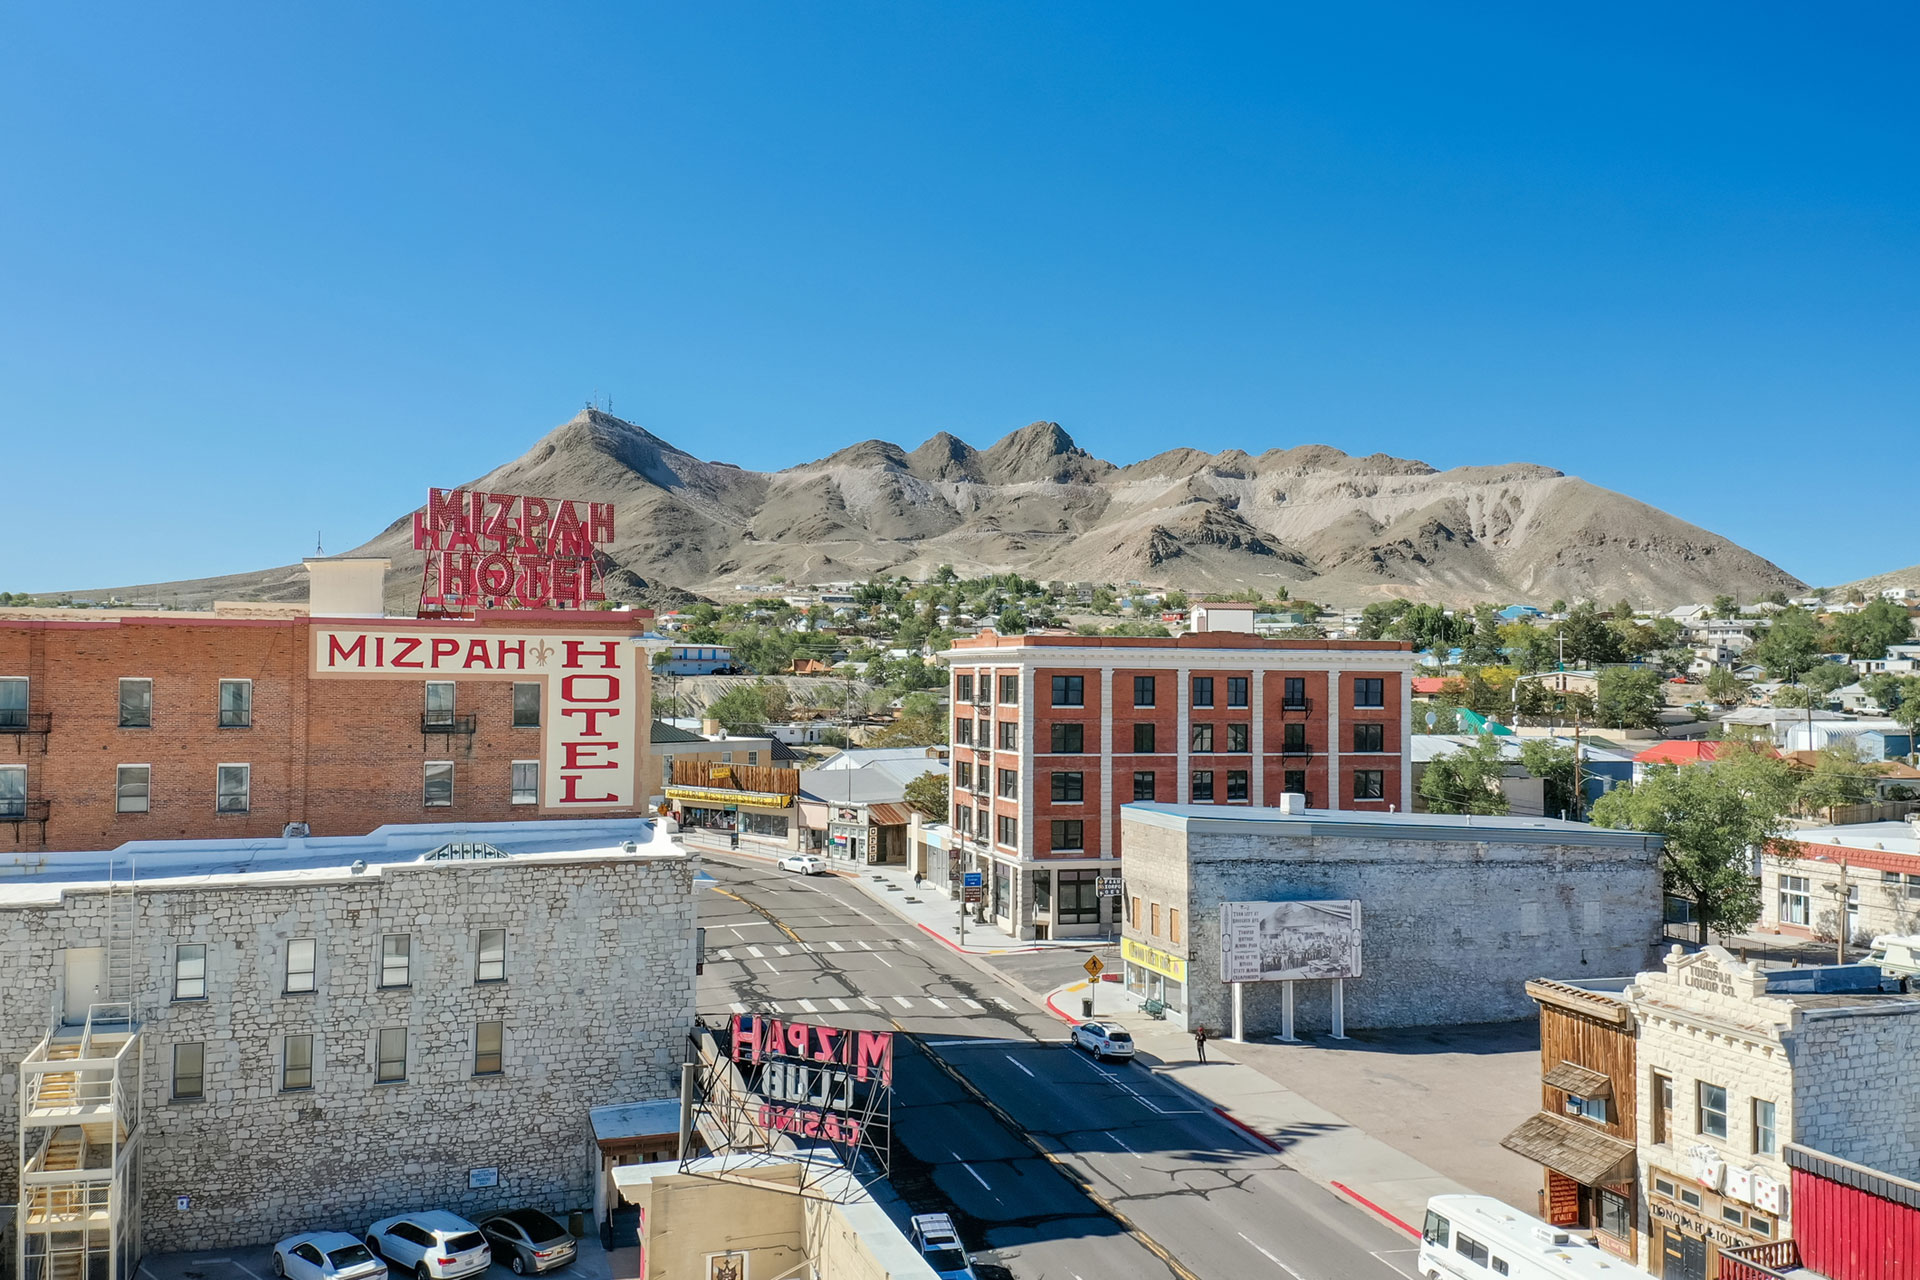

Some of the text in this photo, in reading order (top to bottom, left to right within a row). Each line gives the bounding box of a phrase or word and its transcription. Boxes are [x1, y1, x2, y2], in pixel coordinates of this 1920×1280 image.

[427, 487, 615, 544] MIZPAH
[441, 552, 606, 602] HOTEL
[328, 634, 526, 669] MIZPAH
[559, 640, 621, 803] HOTEL
[704, 792, 739, 803] WESTERN
[741, 796, 766, 806] STORE
[1685, 975, 1719, 994] LIQUOR
[1690, 966, 1732, 986] TONOPAH
